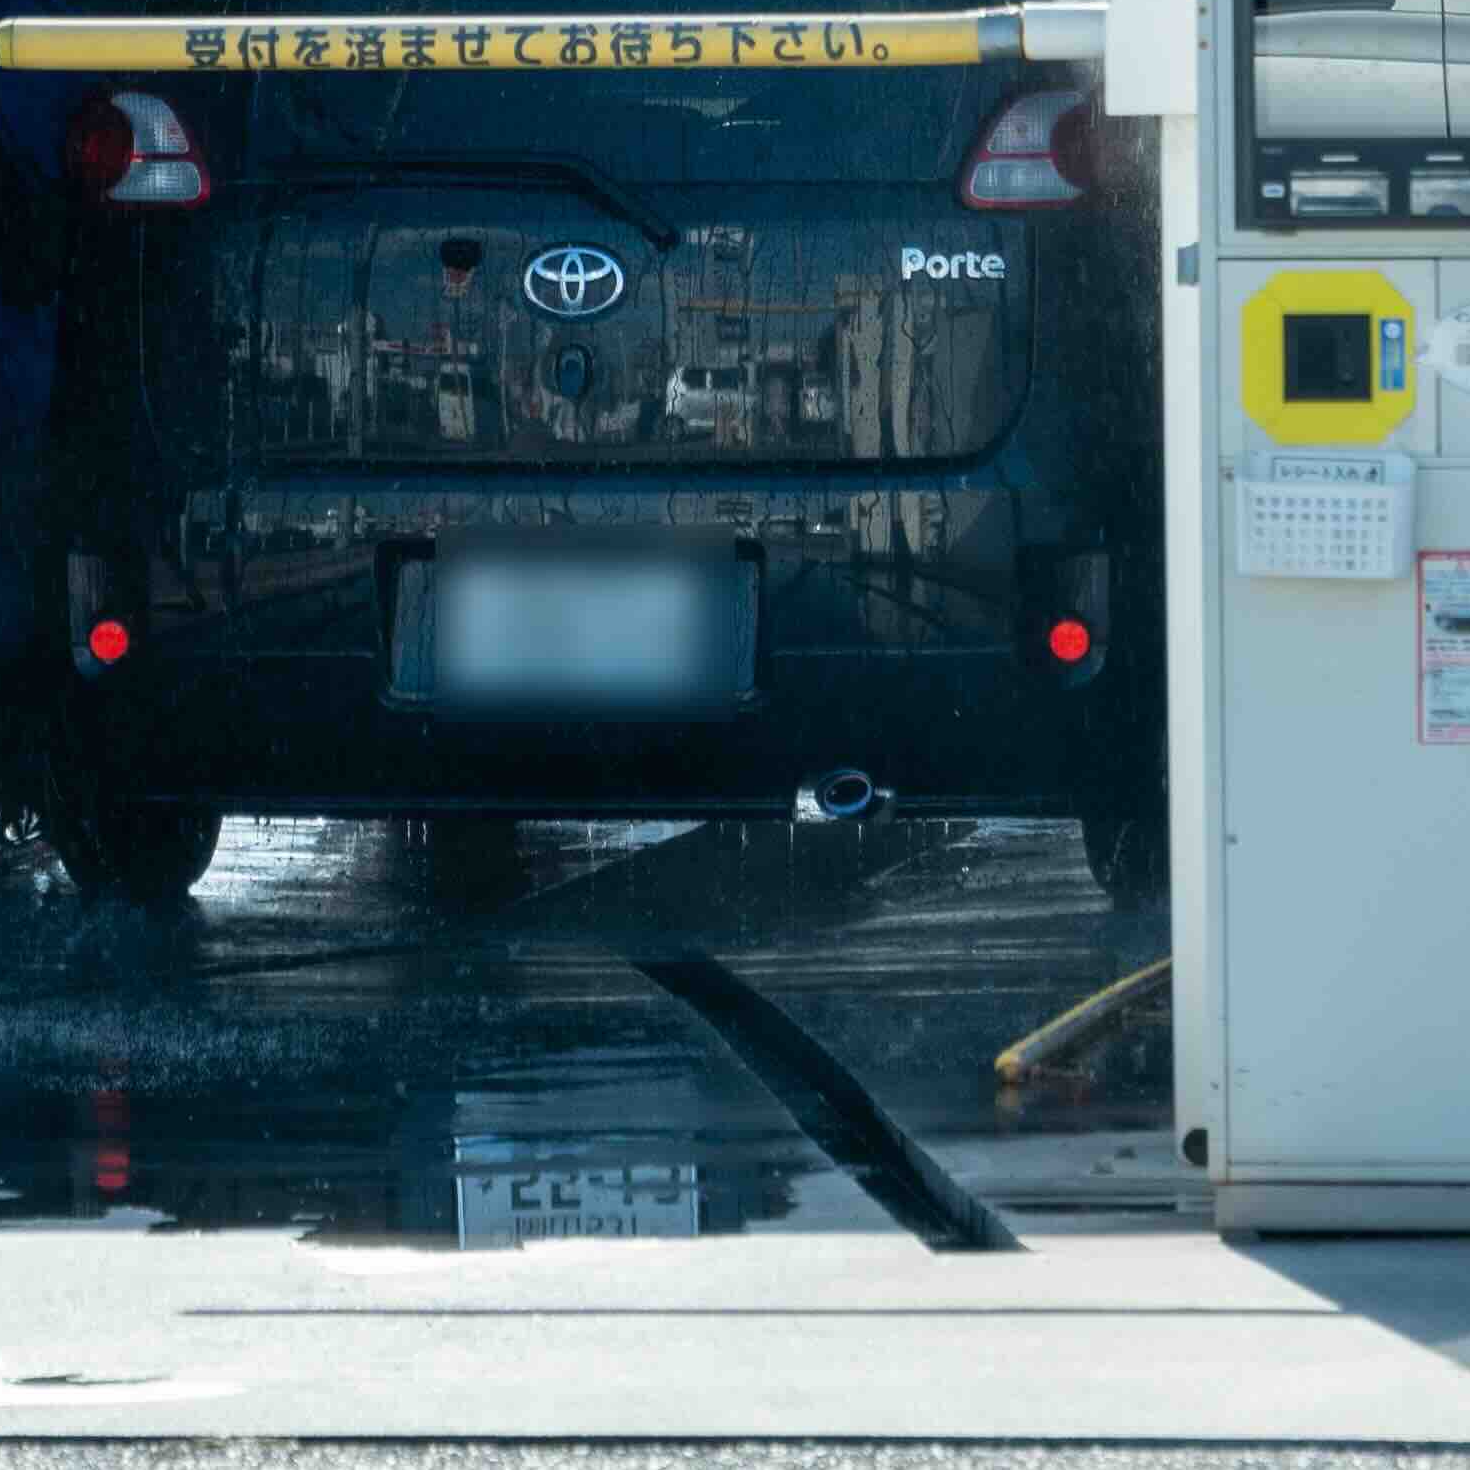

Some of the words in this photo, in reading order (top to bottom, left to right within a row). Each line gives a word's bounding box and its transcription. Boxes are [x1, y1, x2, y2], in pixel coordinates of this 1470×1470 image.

[184, 20, 890, 69] 受付を済ませてお待ち下さい。
[900, 246, 1006, 281] Porte
